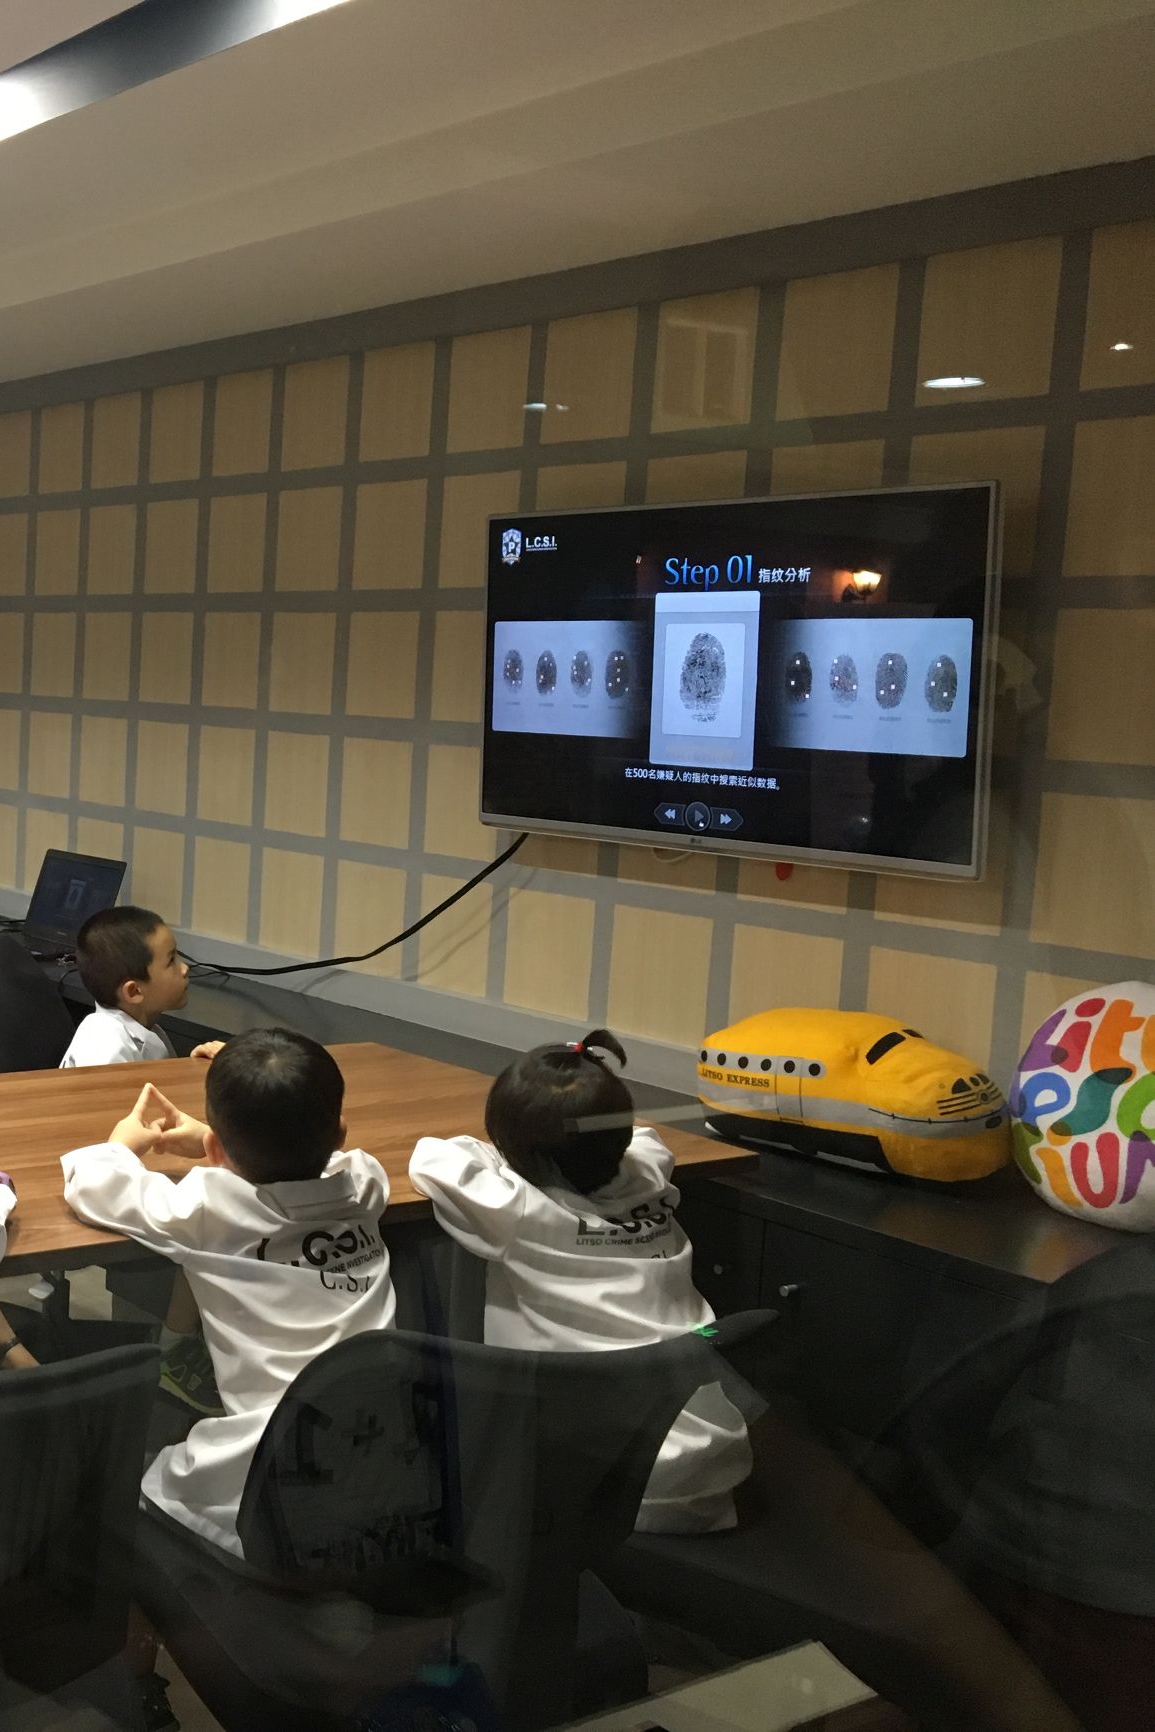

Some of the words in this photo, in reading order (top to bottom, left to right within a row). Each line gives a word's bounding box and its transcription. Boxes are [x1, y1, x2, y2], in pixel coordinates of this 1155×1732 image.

[525, 535, 557, 548] L.C.S.I.
[664, 557, 720, 591] Step
[726, 555, 753, 584] 01
[758, 567, 812, 583] 指纹分析
[726, 1073, 770, 1088] EXPRESS
[576, 1238, 603, 1246] LITSO
[605, 1238, 633, 1246] CRIME
